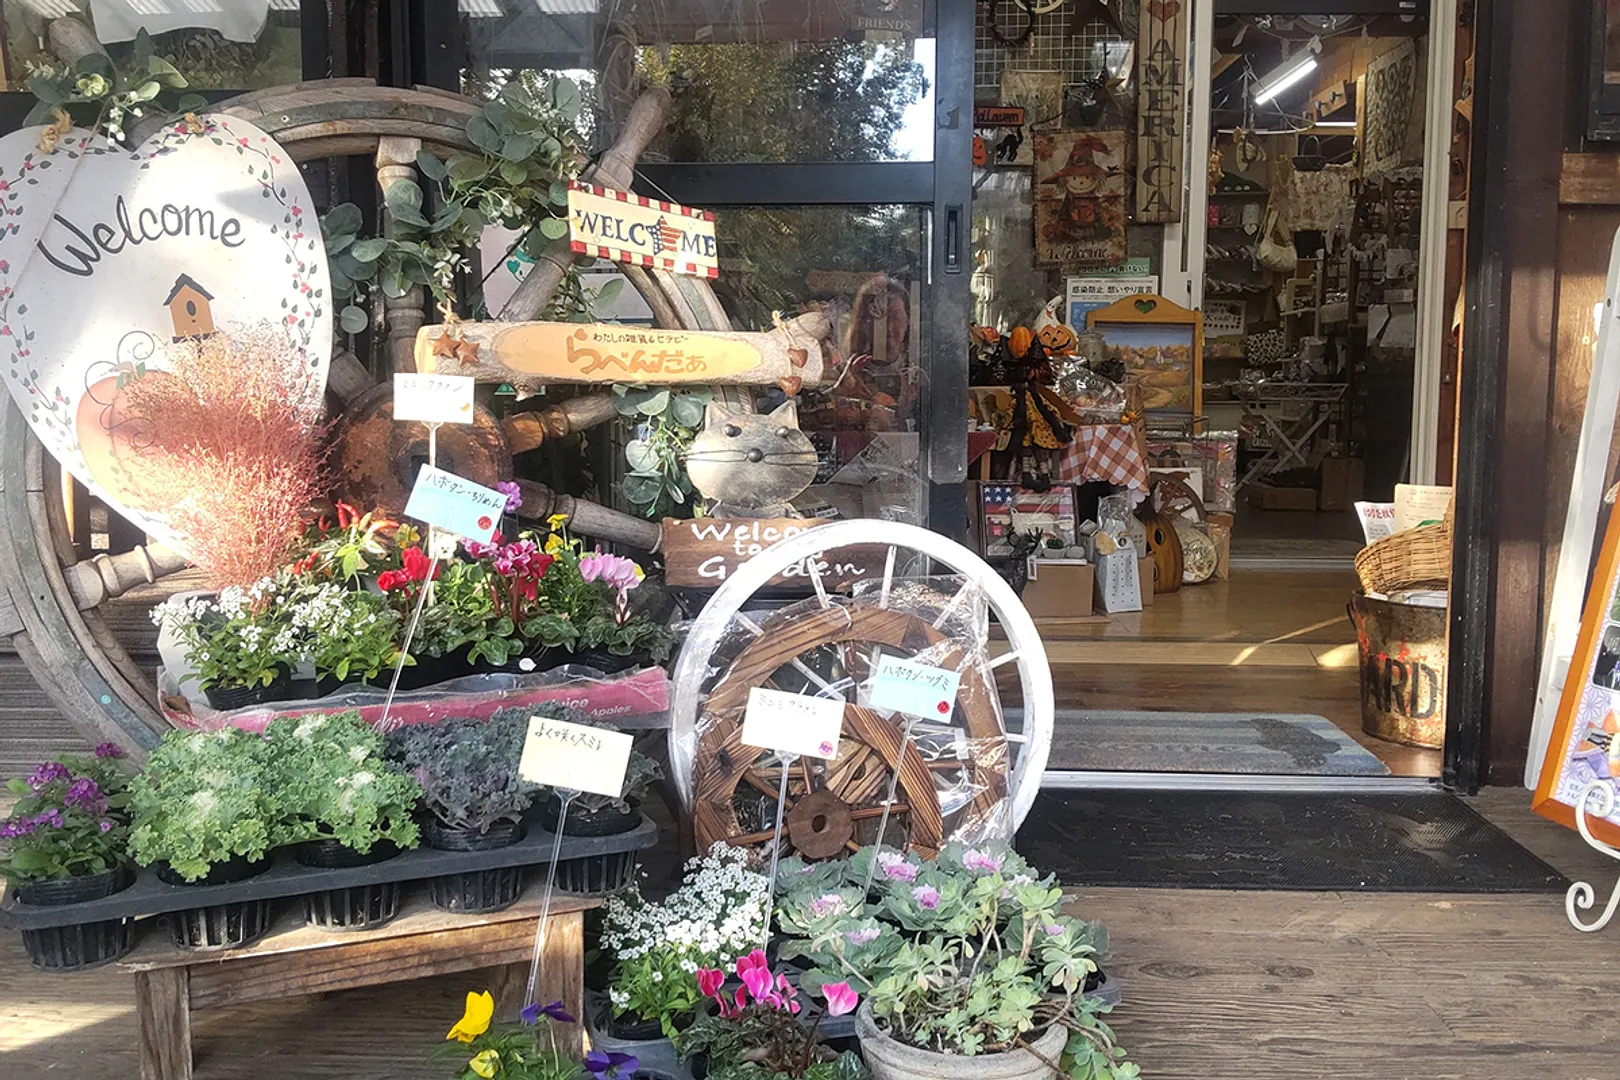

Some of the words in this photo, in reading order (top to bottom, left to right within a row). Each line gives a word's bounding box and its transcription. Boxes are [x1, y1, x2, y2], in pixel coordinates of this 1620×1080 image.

[858, 18, 912, 31] FRIENDS
[1140, 39, 1183, 213] AMERICA
[36, 194, 246, 277] Welcome
[575, 209, 718, 258] WELCME
[697, 556, 865, 580] Gden
[590, 704, 632, 717] Apples
